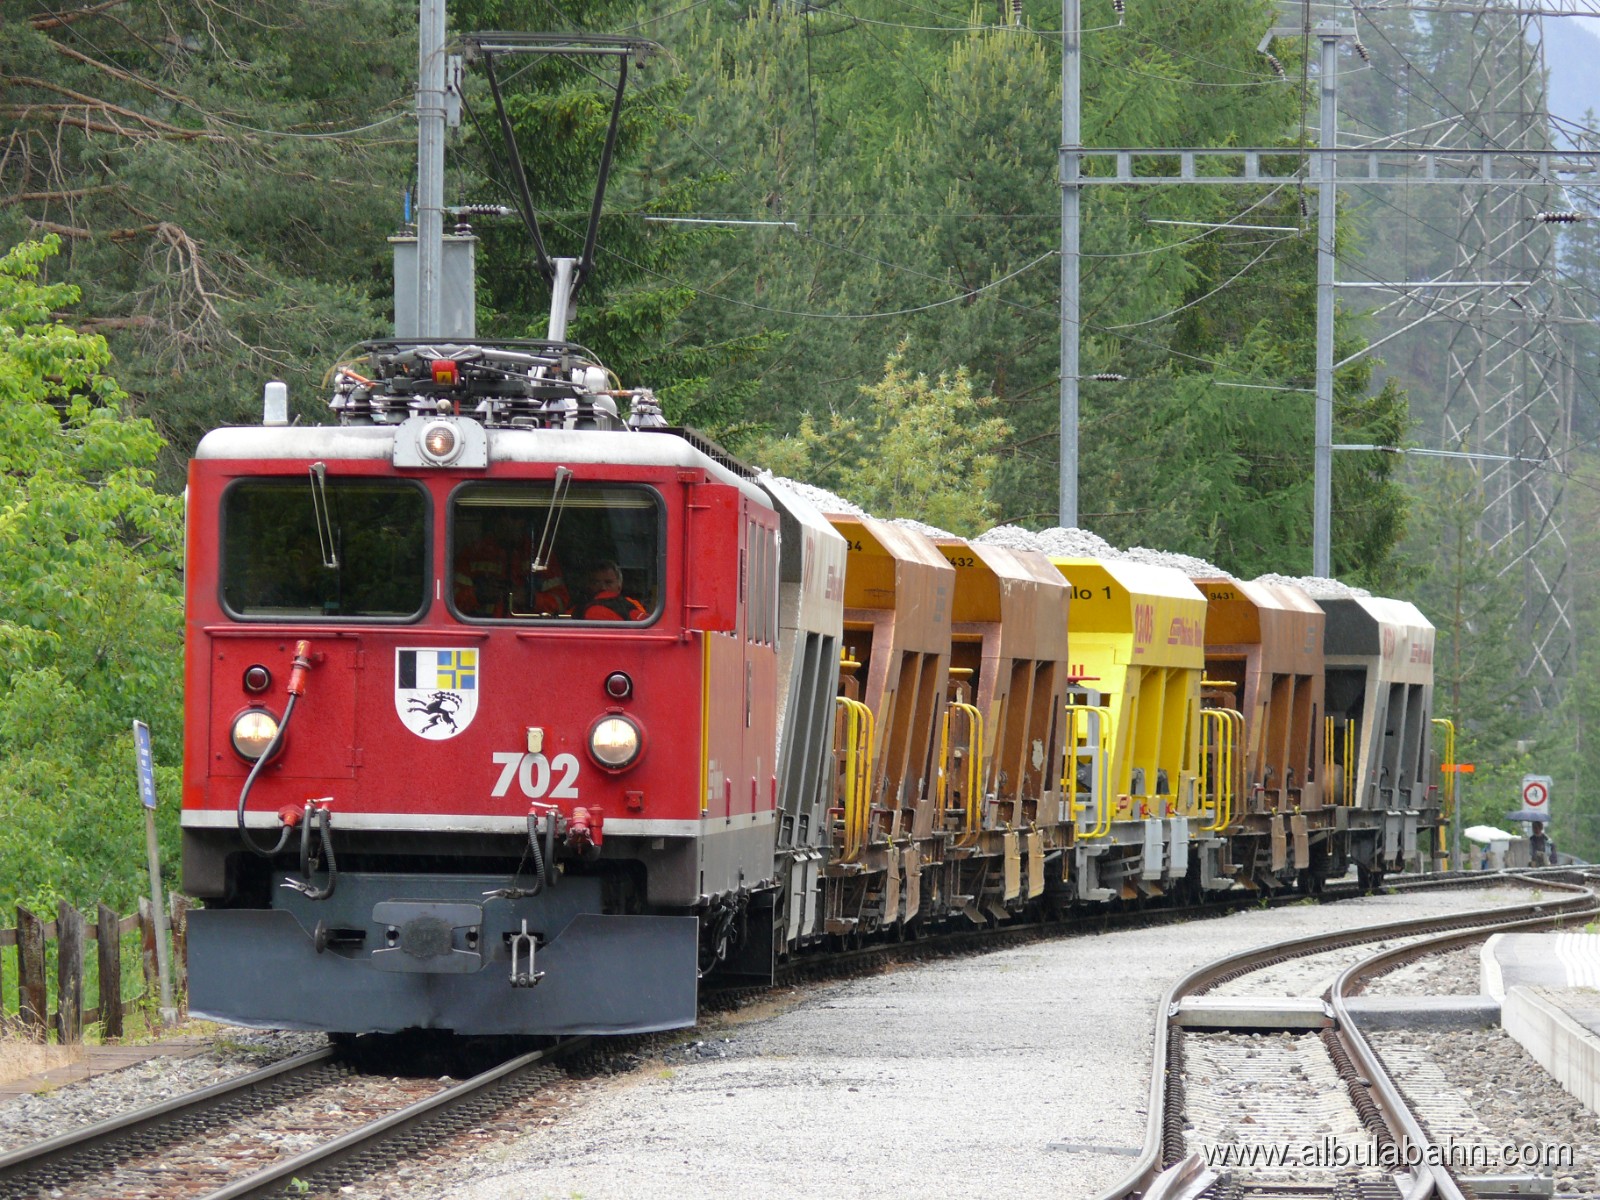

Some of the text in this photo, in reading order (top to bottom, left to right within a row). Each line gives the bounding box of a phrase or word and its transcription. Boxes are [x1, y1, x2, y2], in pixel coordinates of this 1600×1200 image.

[946, 557, 974, 567] 432
[1102, 586, 1111, 599] 1
[1210, 592, 1234, 601] 9431
[490, 752, 580, 799] 702
